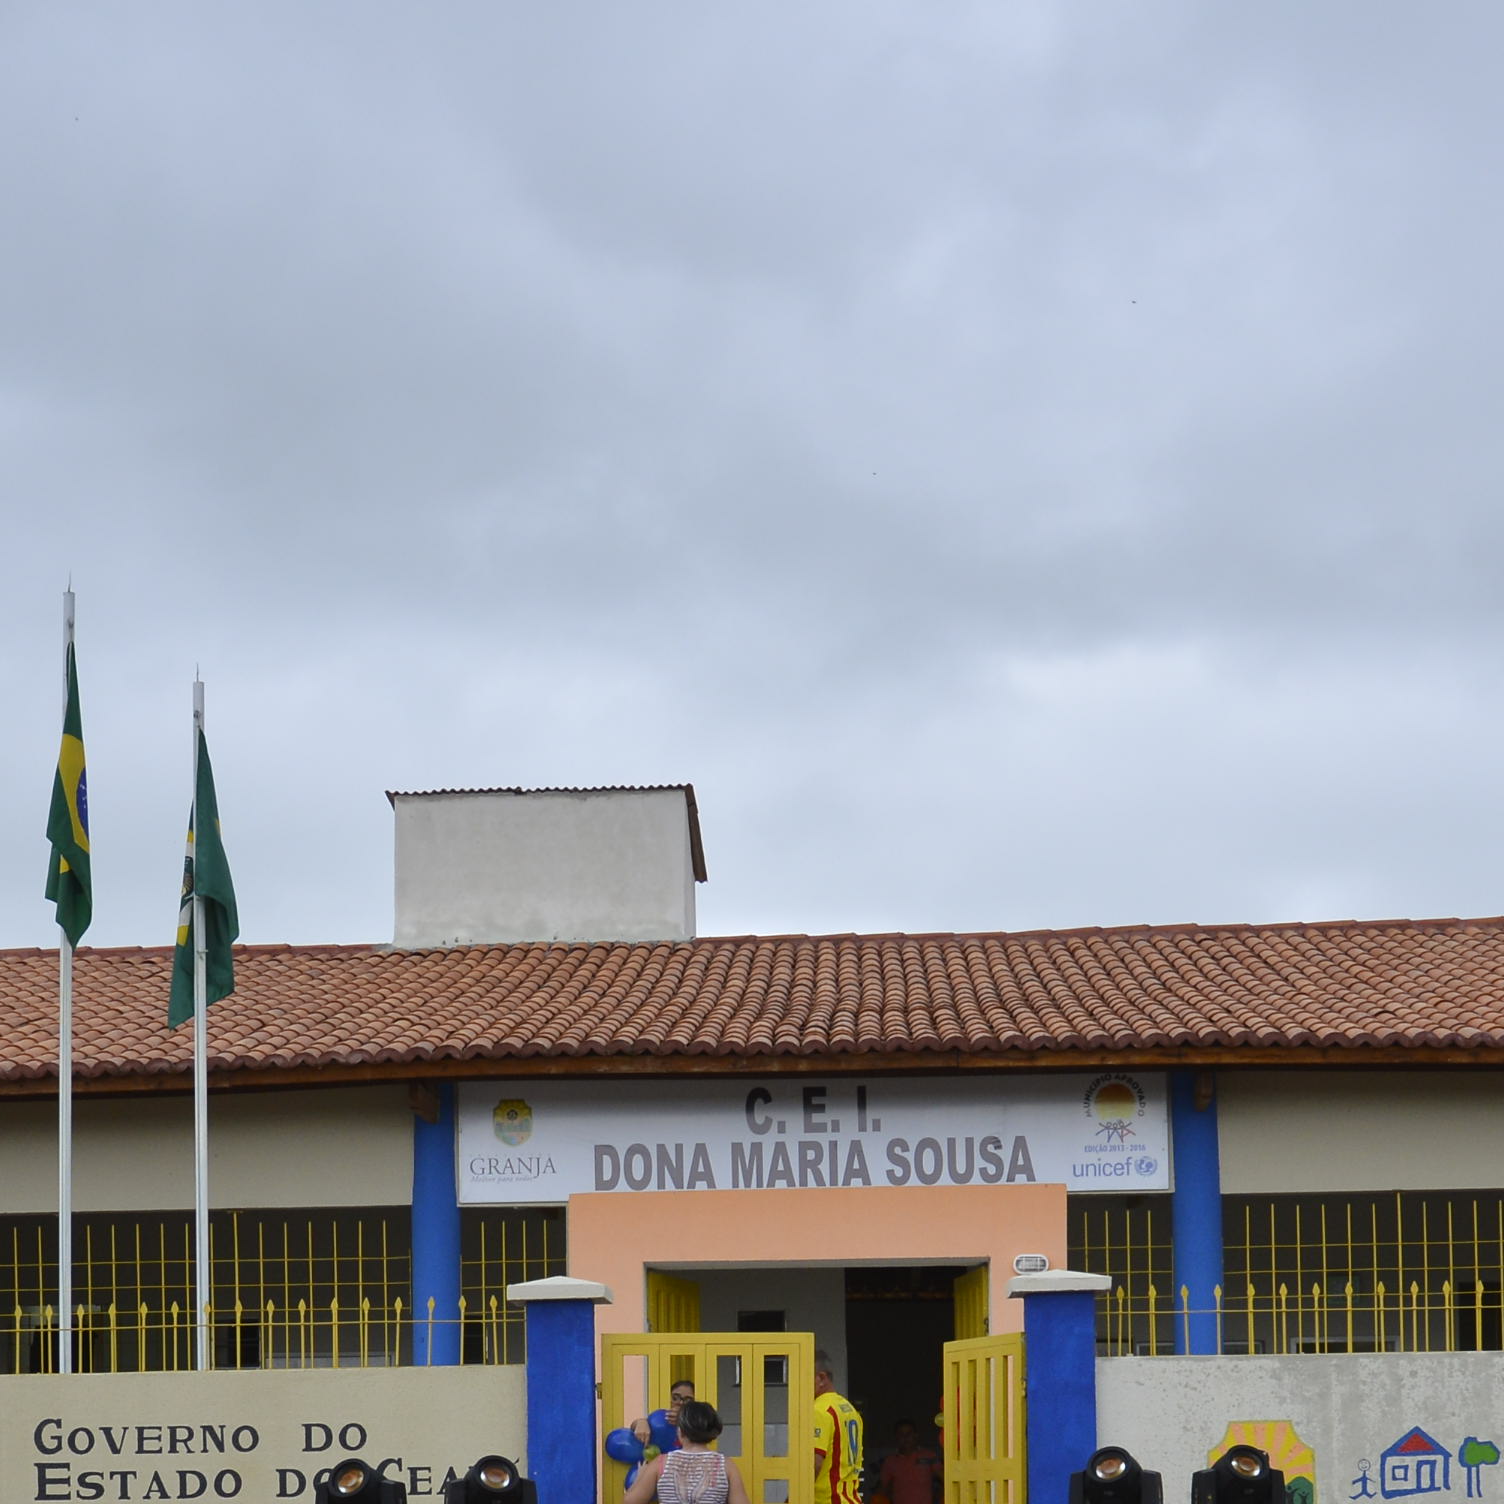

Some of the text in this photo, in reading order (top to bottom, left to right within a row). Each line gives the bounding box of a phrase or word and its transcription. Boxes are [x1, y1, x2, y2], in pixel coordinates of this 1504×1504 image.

[469, 1156, 556, 1179] GRANJA
[594, 1135, 1036, 1191] DONA MARIA SOUSA
[1072, 1156, 1133, 1177] unicef
[33, 1418, 368, 1455] GOVERNO DO
[33, 1462, 243, 1501] ESTADO
